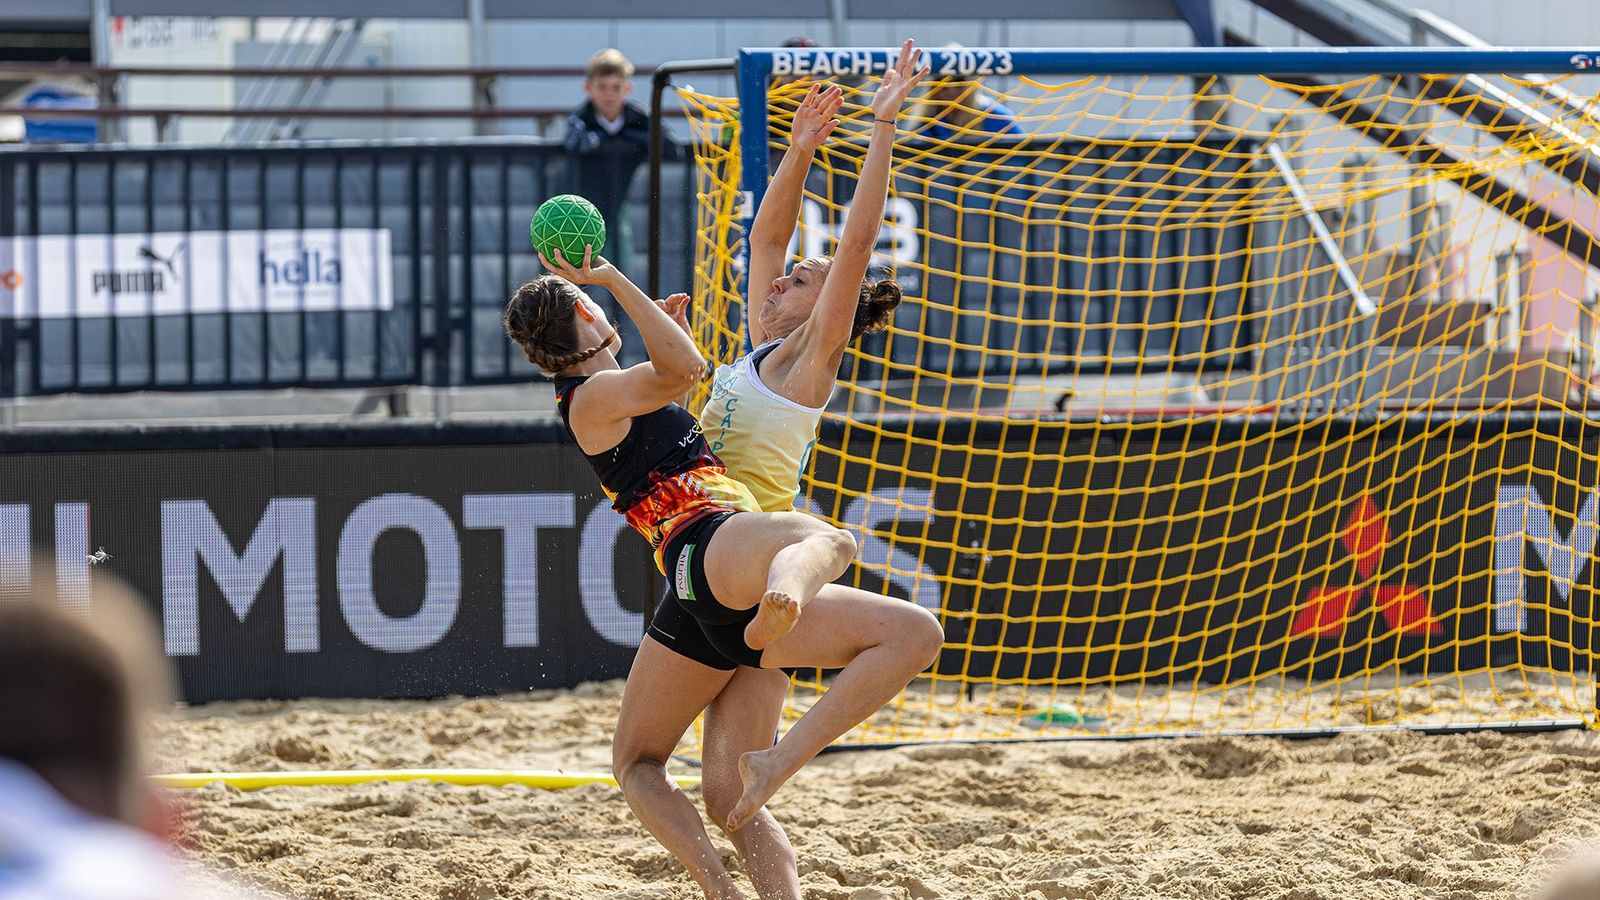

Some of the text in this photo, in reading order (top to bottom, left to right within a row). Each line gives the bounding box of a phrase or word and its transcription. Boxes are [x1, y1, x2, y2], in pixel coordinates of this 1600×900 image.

[939, 49, 1014, 76] 2023
[259, 250, 342, 284] hella
[92, 271, 165, 294] PUMA
